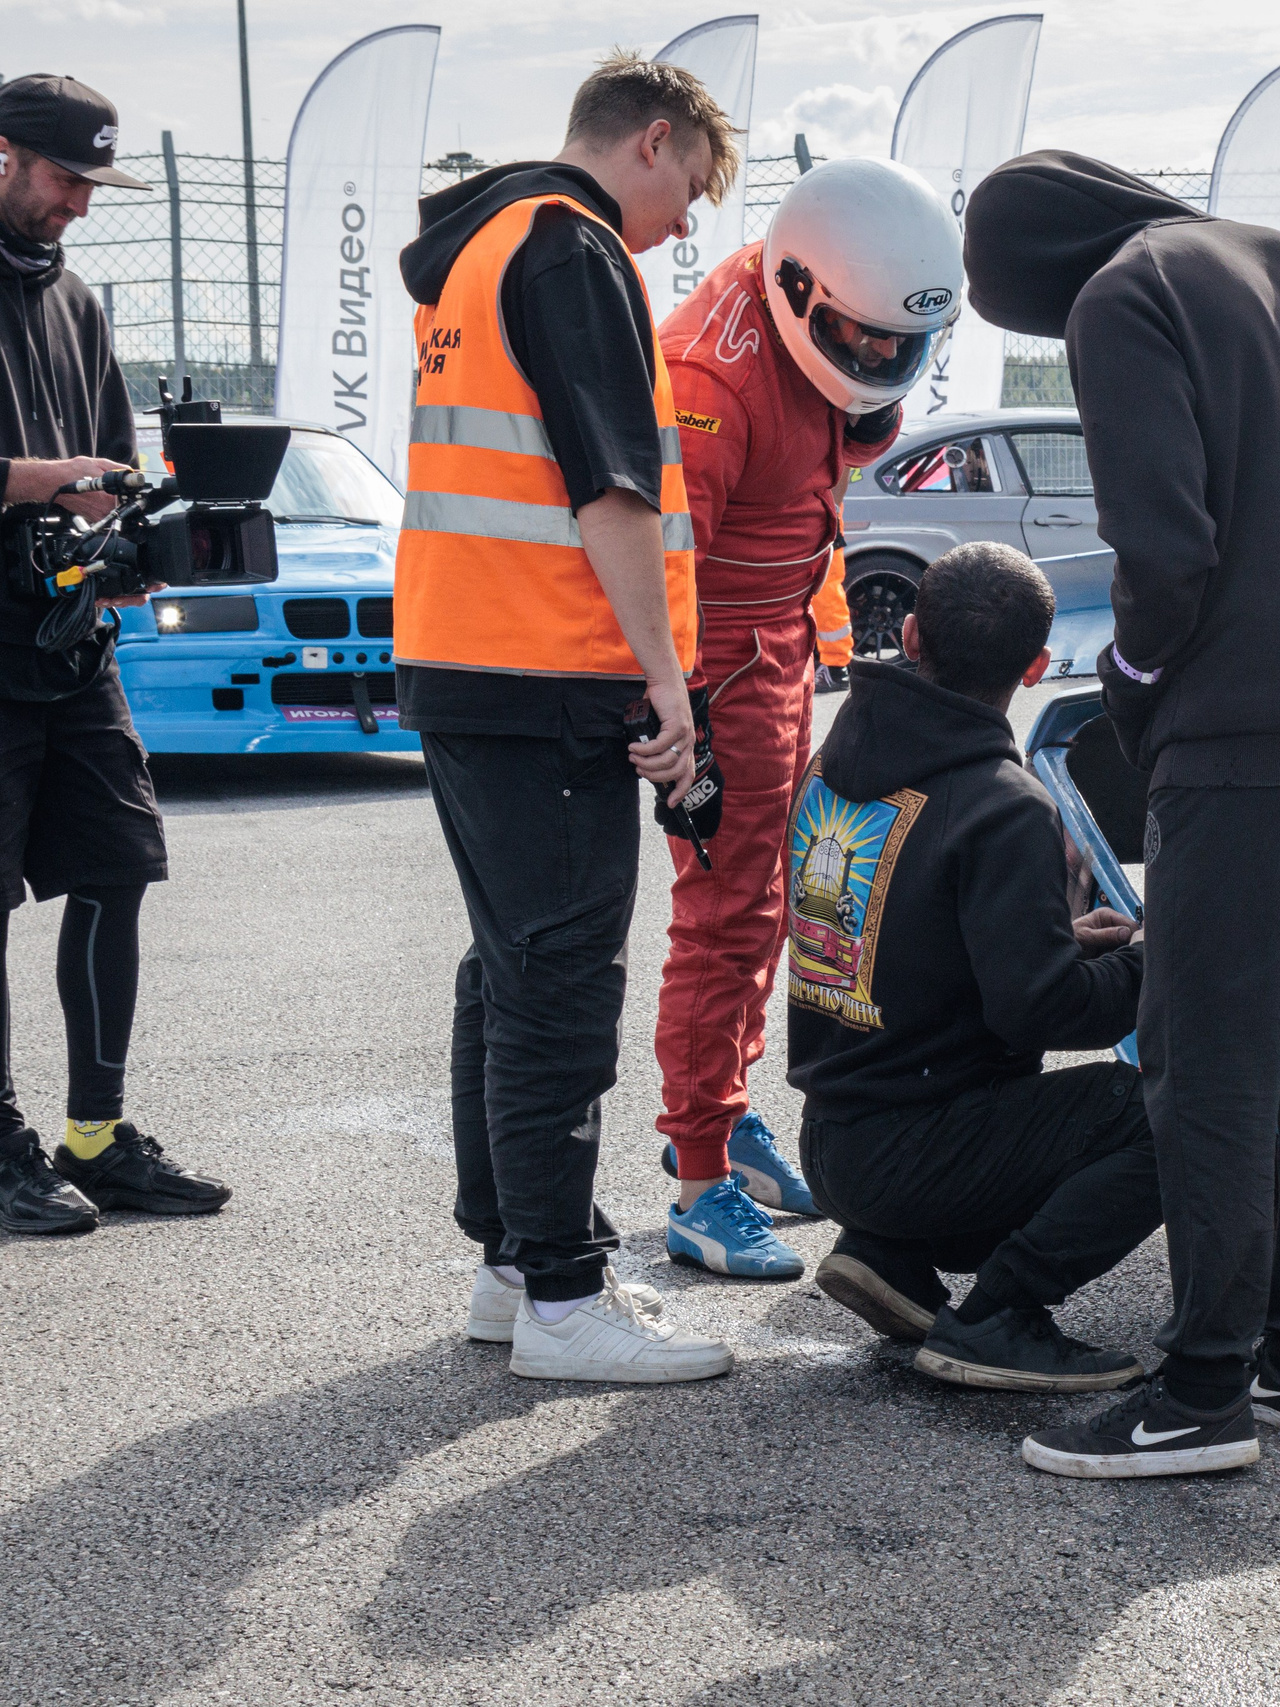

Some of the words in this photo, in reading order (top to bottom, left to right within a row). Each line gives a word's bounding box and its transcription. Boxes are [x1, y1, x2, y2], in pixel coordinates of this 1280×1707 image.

[907, 290, 949, 309] Arai
[332, 370, 368, 432] VK
[289, 710, 356, 719] ИГОРА
